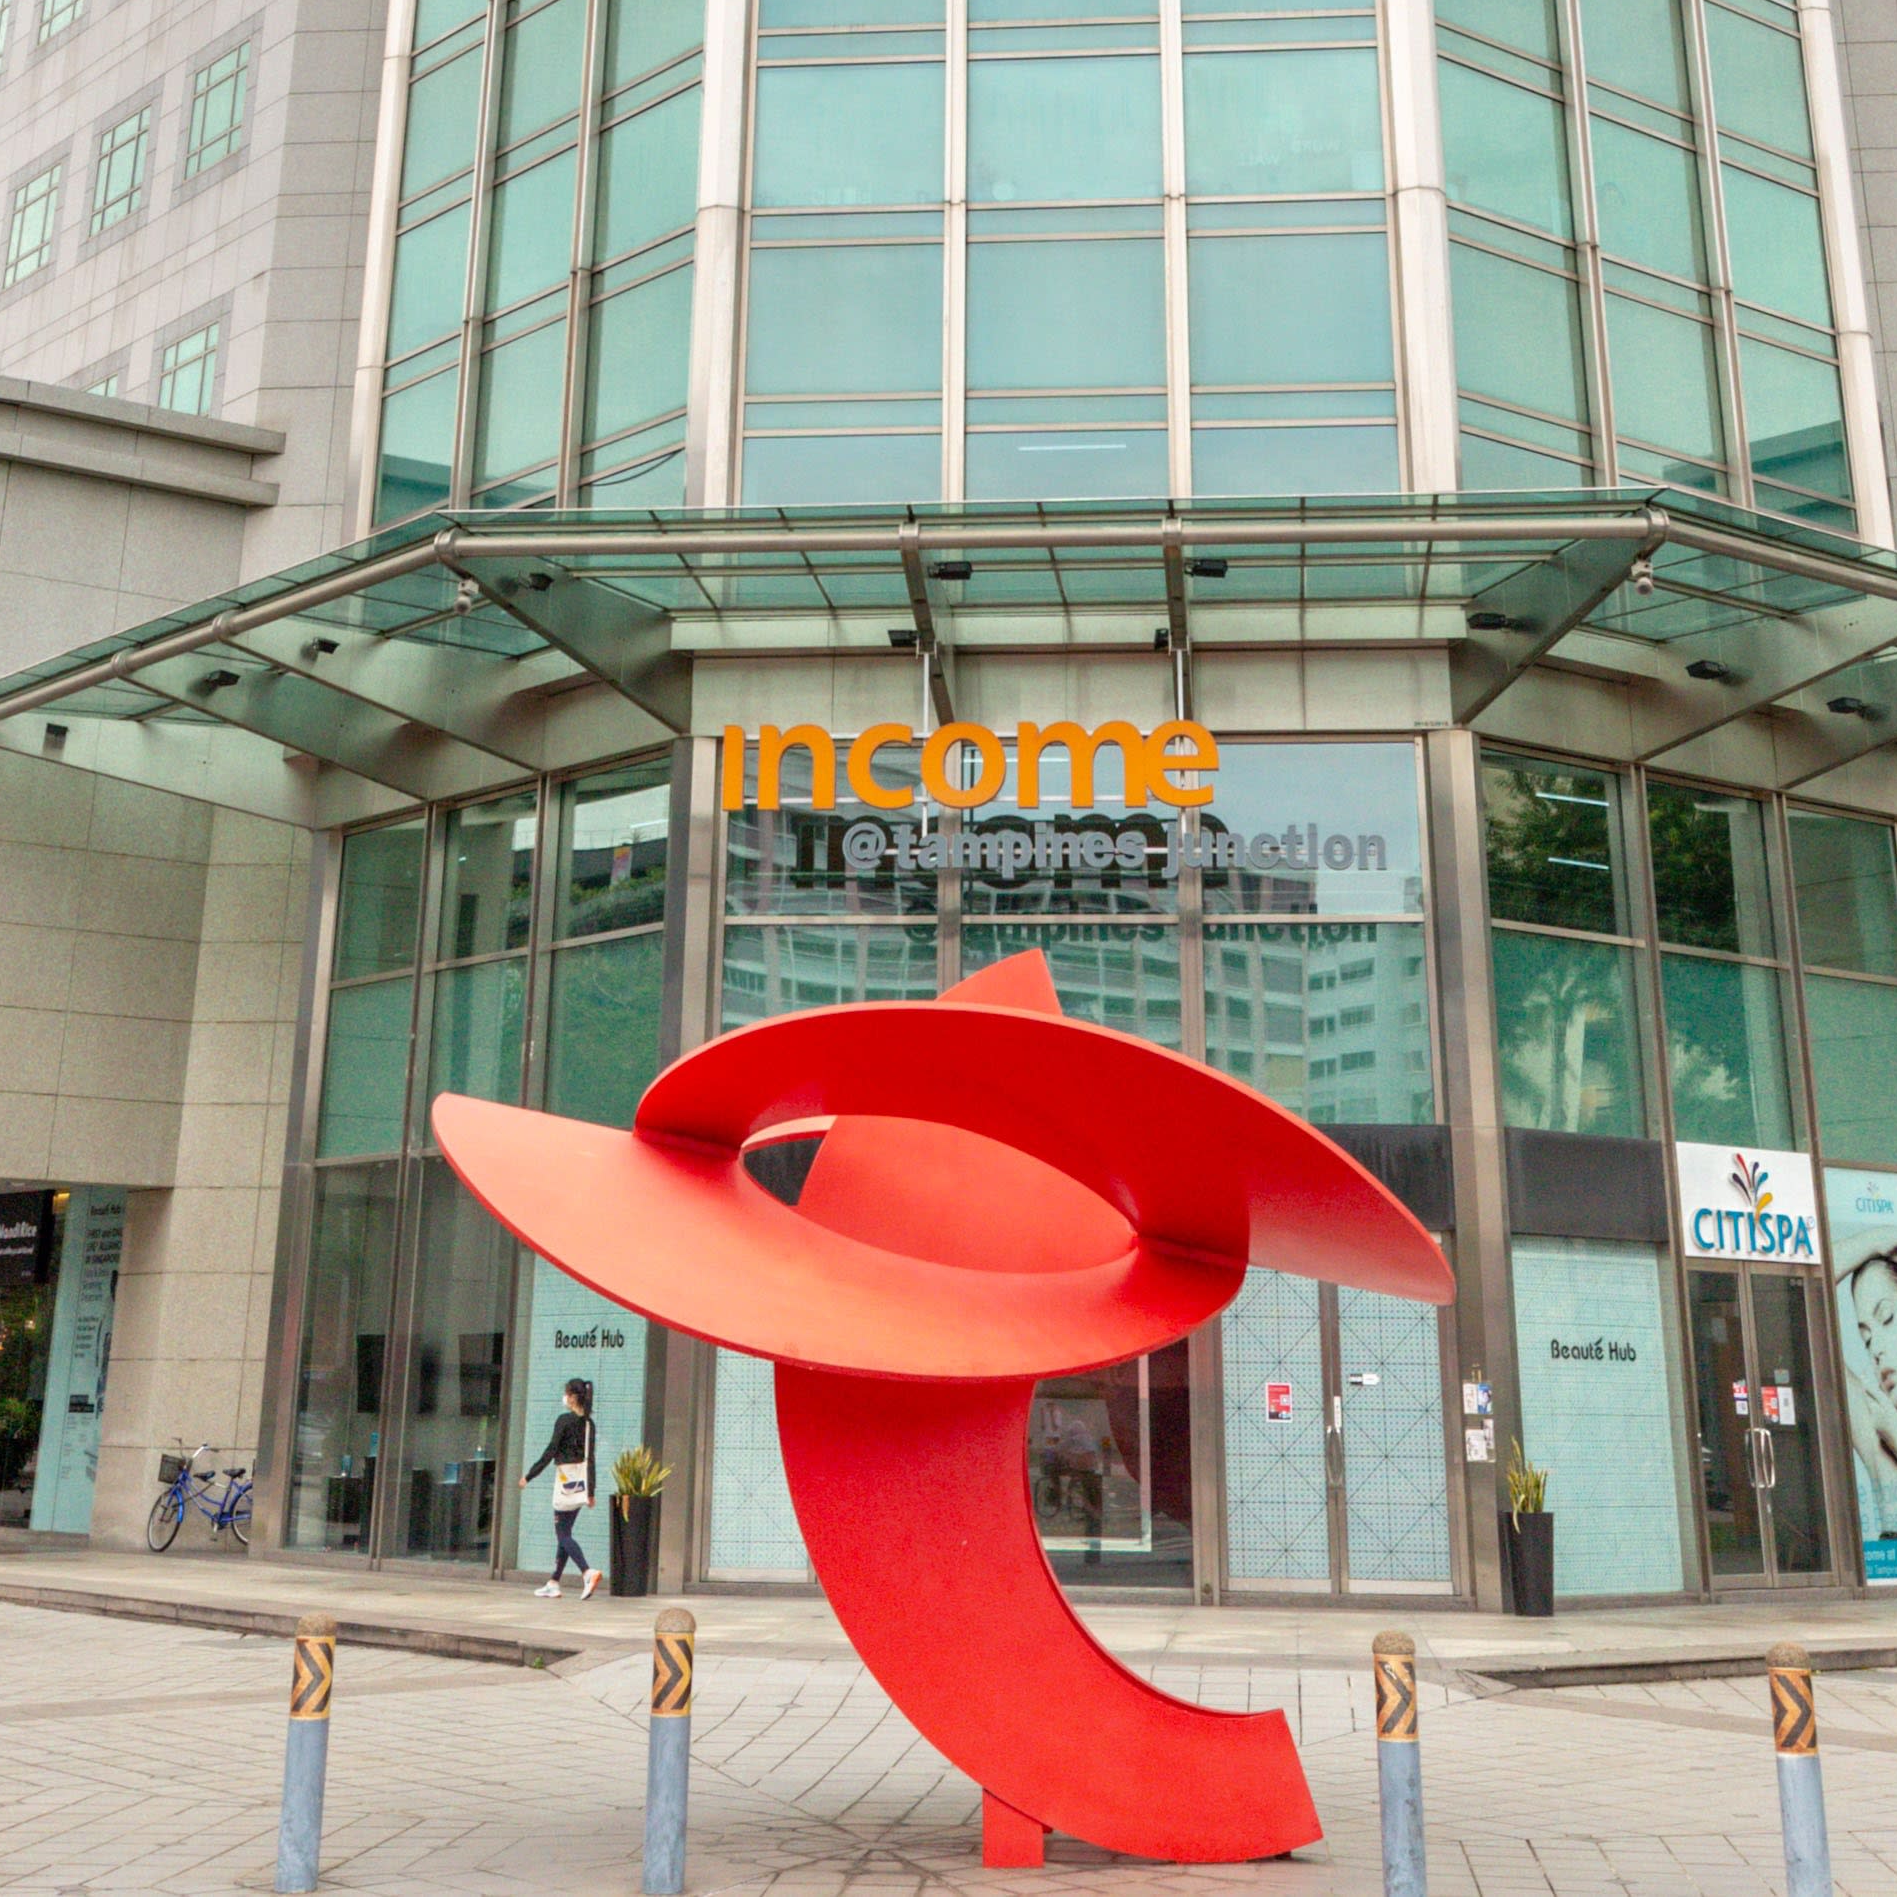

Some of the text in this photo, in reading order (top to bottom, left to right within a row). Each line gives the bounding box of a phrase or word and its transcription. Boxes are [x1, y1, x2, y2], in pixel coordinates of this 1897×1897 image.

[721, 719, 1220, 812] income
[842, 821, 1388, 880] @tampines junction
[1693, 1207, 1814, 1256] CITISPA
[554, 1324, 625, 1349] Beauté Hub
[1550, 1336, 1637, 1362] Beauté Hub
